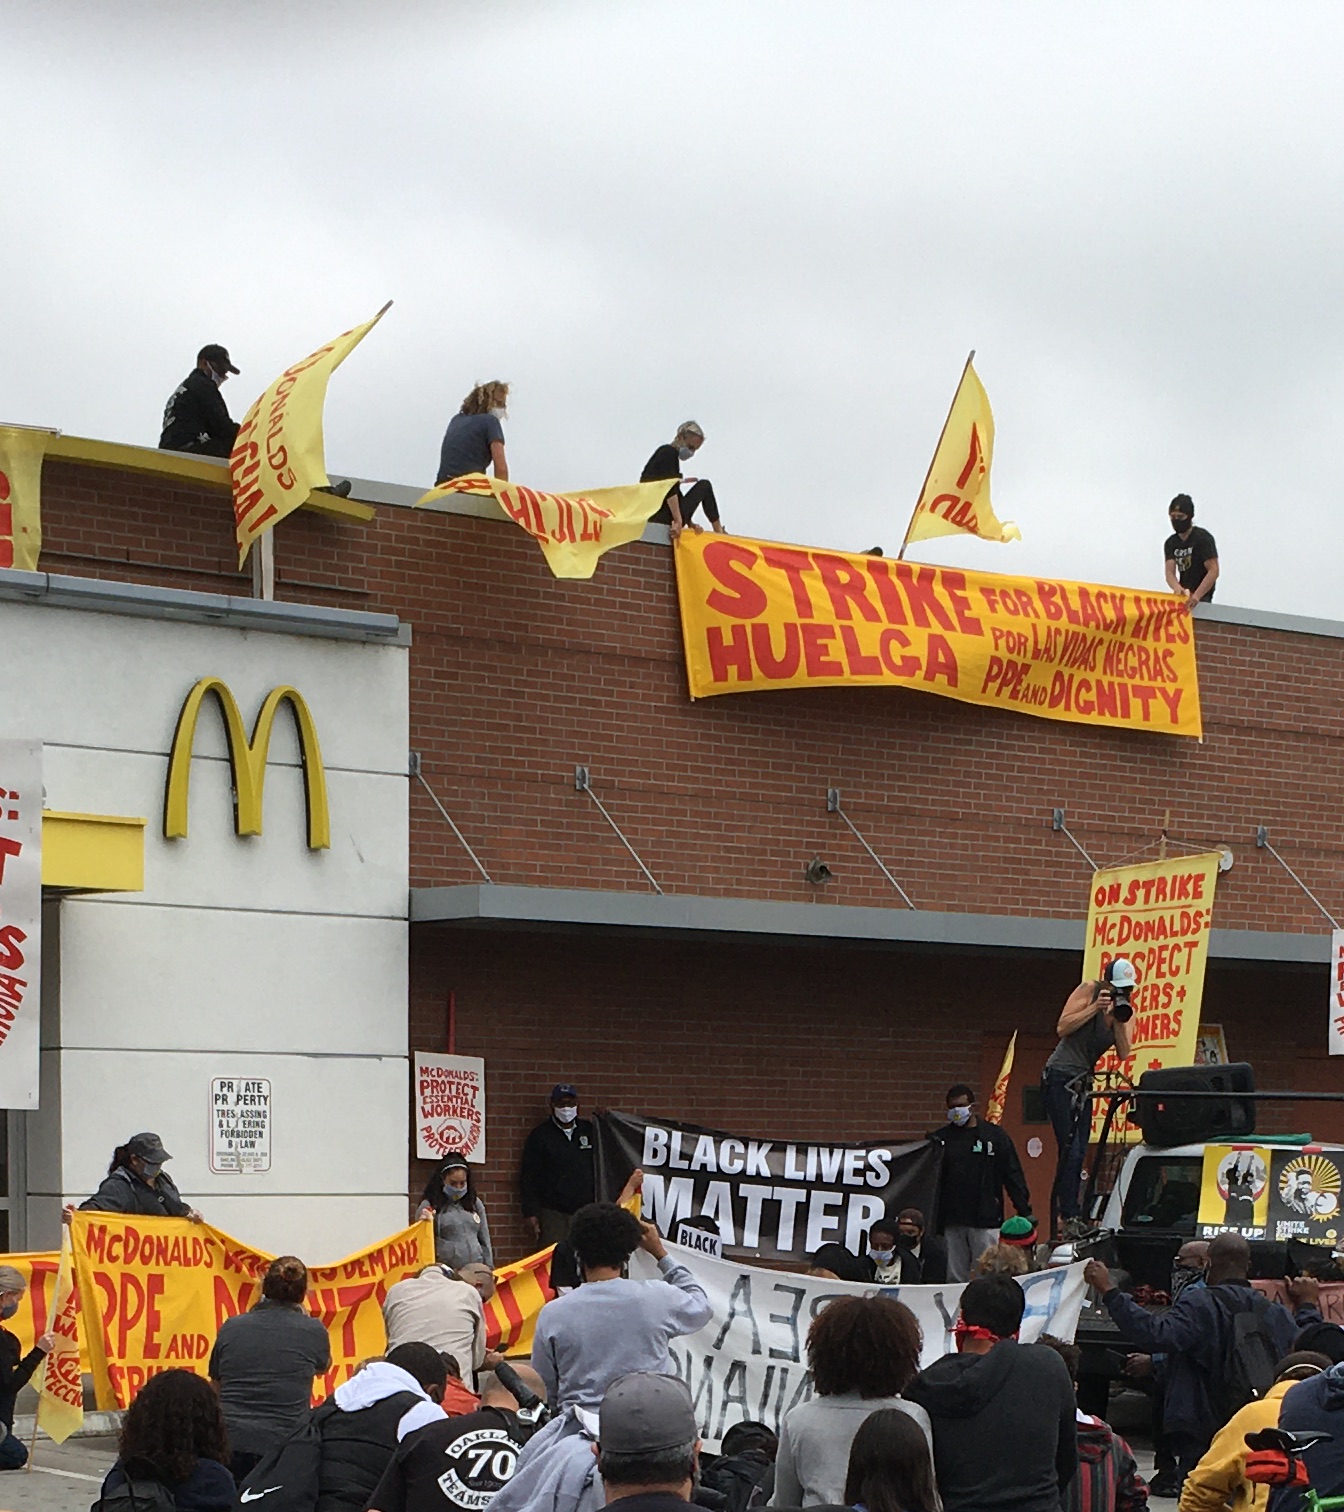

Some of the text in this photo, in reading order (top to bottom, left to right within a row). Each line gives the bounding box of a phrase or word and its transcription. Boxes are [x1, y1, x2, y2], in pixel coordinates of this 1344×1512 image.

[703, 541, 1191, 645] STRIKE FOR BLACK LIVES
[706, 622, 1178, 687] HUELGA POR LAS VIDAS NEGRAS
[981, 655, 1184, 724] PPE AND DIGNITY
[1095, 873, 1205, 908] ON STRIKE
[220, 1081, 263, 1093] PRATE
[419, 1079, 479, 1099] PROTECT
[215, 1094, 269, 1106] PRPERTY
[423, 1095, 475, 1108] ESSENTIAL
[216, 1109, 268, 1118] TRESASSING
[421, 1105, 481, 1123] WORKERS
[220, 1130, 263, 1139] FORBIDDEN
[240, 1140, 256, 1149] LAW
[642, 1126, 892, 1188] BLACK LIVES
[639, 1174, 887, 1258] MATTER
[680, 1229, 718, 1256] BLACK
[1241, 1228, 1264, 1237] UP
[165, 1333, 209, 1359] AND
[468, 1449, 516, 1481] 70
